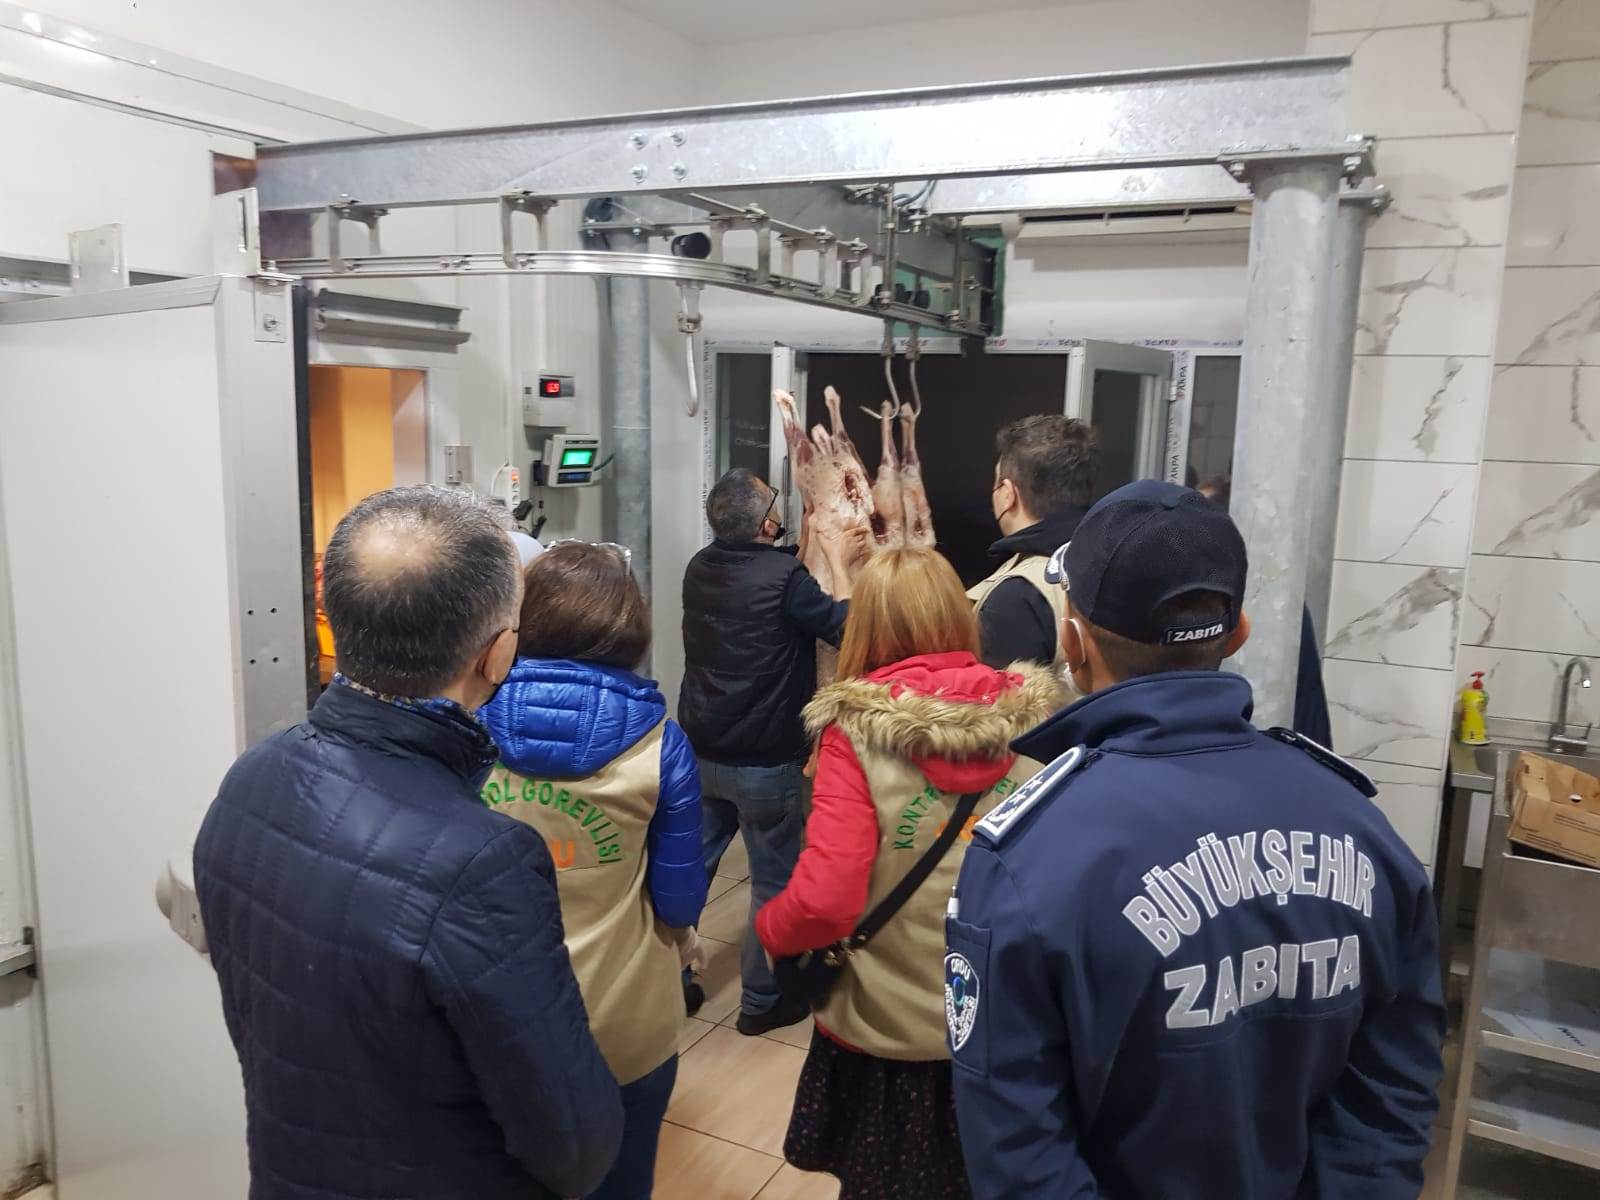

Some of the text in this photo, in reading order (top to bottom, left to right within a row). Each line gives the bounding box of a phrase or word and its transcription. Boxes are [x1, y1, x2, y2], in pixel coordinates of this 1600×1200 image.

[1173, 623, 1223, 642] ZABITA
[480, 777, 516, 806] OL
[893, 785, 941, 849] KONTR
[1122, 829, 1376, 958] BÜYÜKŞEHİR
[1164, 934, 1361, 1029] ZABITA
